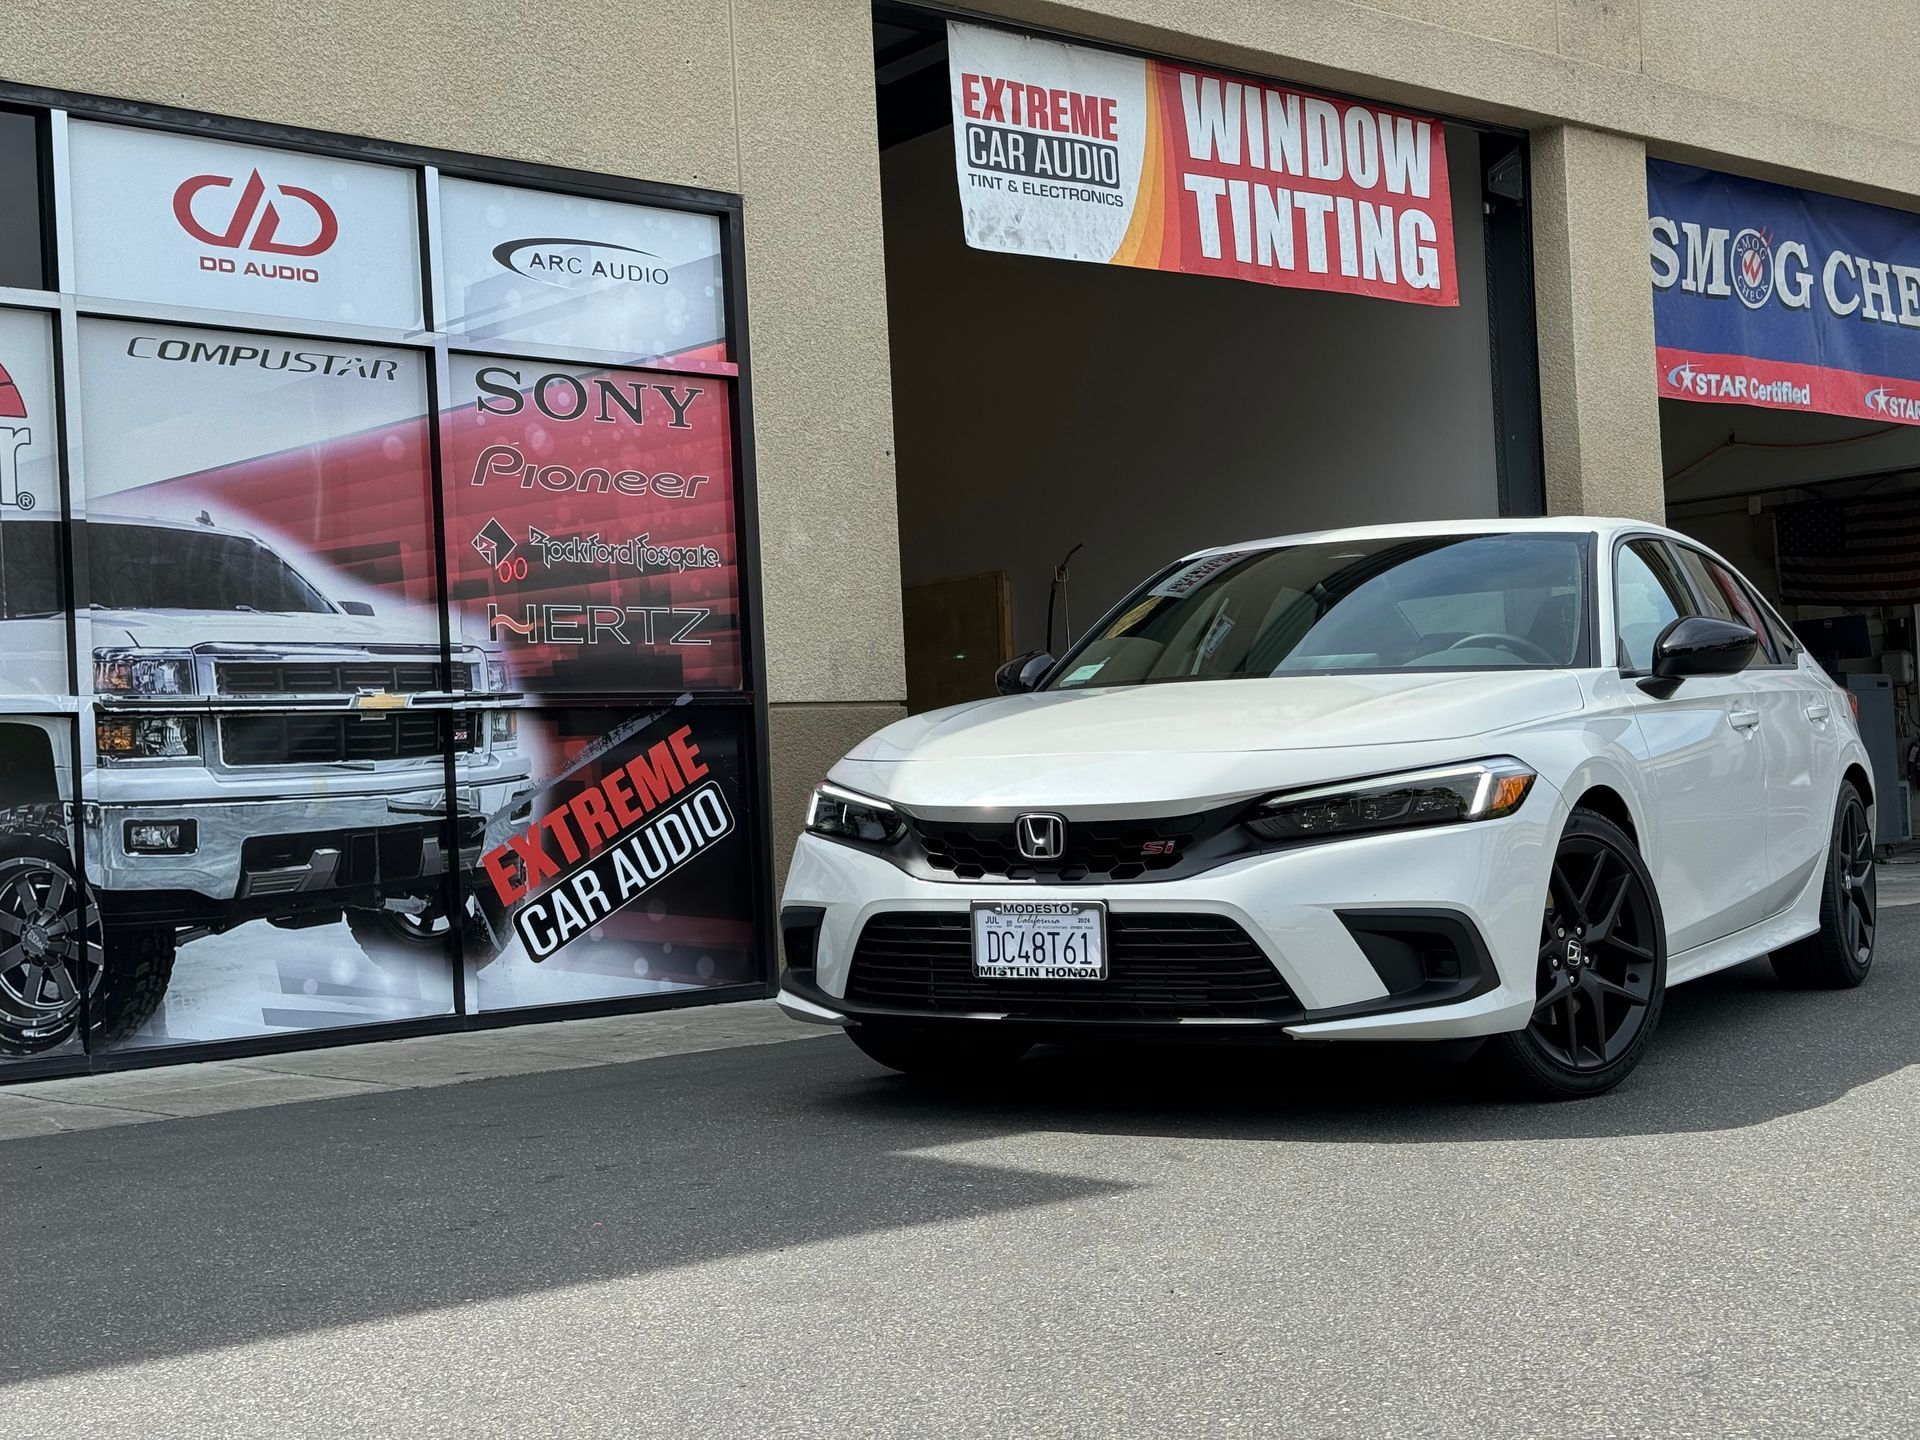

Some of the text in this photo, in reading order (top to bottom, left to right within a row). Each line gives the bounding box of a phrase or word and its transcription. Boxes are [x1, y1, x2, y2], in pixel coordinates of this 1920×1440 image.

[962, 73, 1118, 141] EXTREME
[1179, 71, 1431, 199] WINDOW
[969, 127, 1118, 185] CAR AUDIO
[968, 173, 1124, 207] TINT & ELECTRONICS
[1183, 172, 1441, 290] TINTING
[1737, 236, 1767, 261] SMOG
[199, 256, 319, 283] DD AUDIO
[529, 252, 670, 286] ARC AUDIO
[1648, 216, 1814, 309] SMOG
[1737, 275, 1768, 301] CHECK
[127, 336, 398, 381] COMPUSTAR
[475, 366, 705, 430] SONY
[1696, 373, 1811, 405] STAR Certified
[471, 444, 709, 499] Pioneer
[487, 603, 712, 646] HERTZ
[482, 725, 709, 907] EXTREME
[1140, 840, 1176, 856] Si
[520, 788, 728, 957] CAR AUDIO
[985, 916, 999, 924] JUL
[1016, 914, 1060, 928] California
[1003, 904, 1070, 914] MODESTO
[987, 931, 1093, 965] DC48T61
[980, 966, 1099, 978] MISTLIN HONDA
